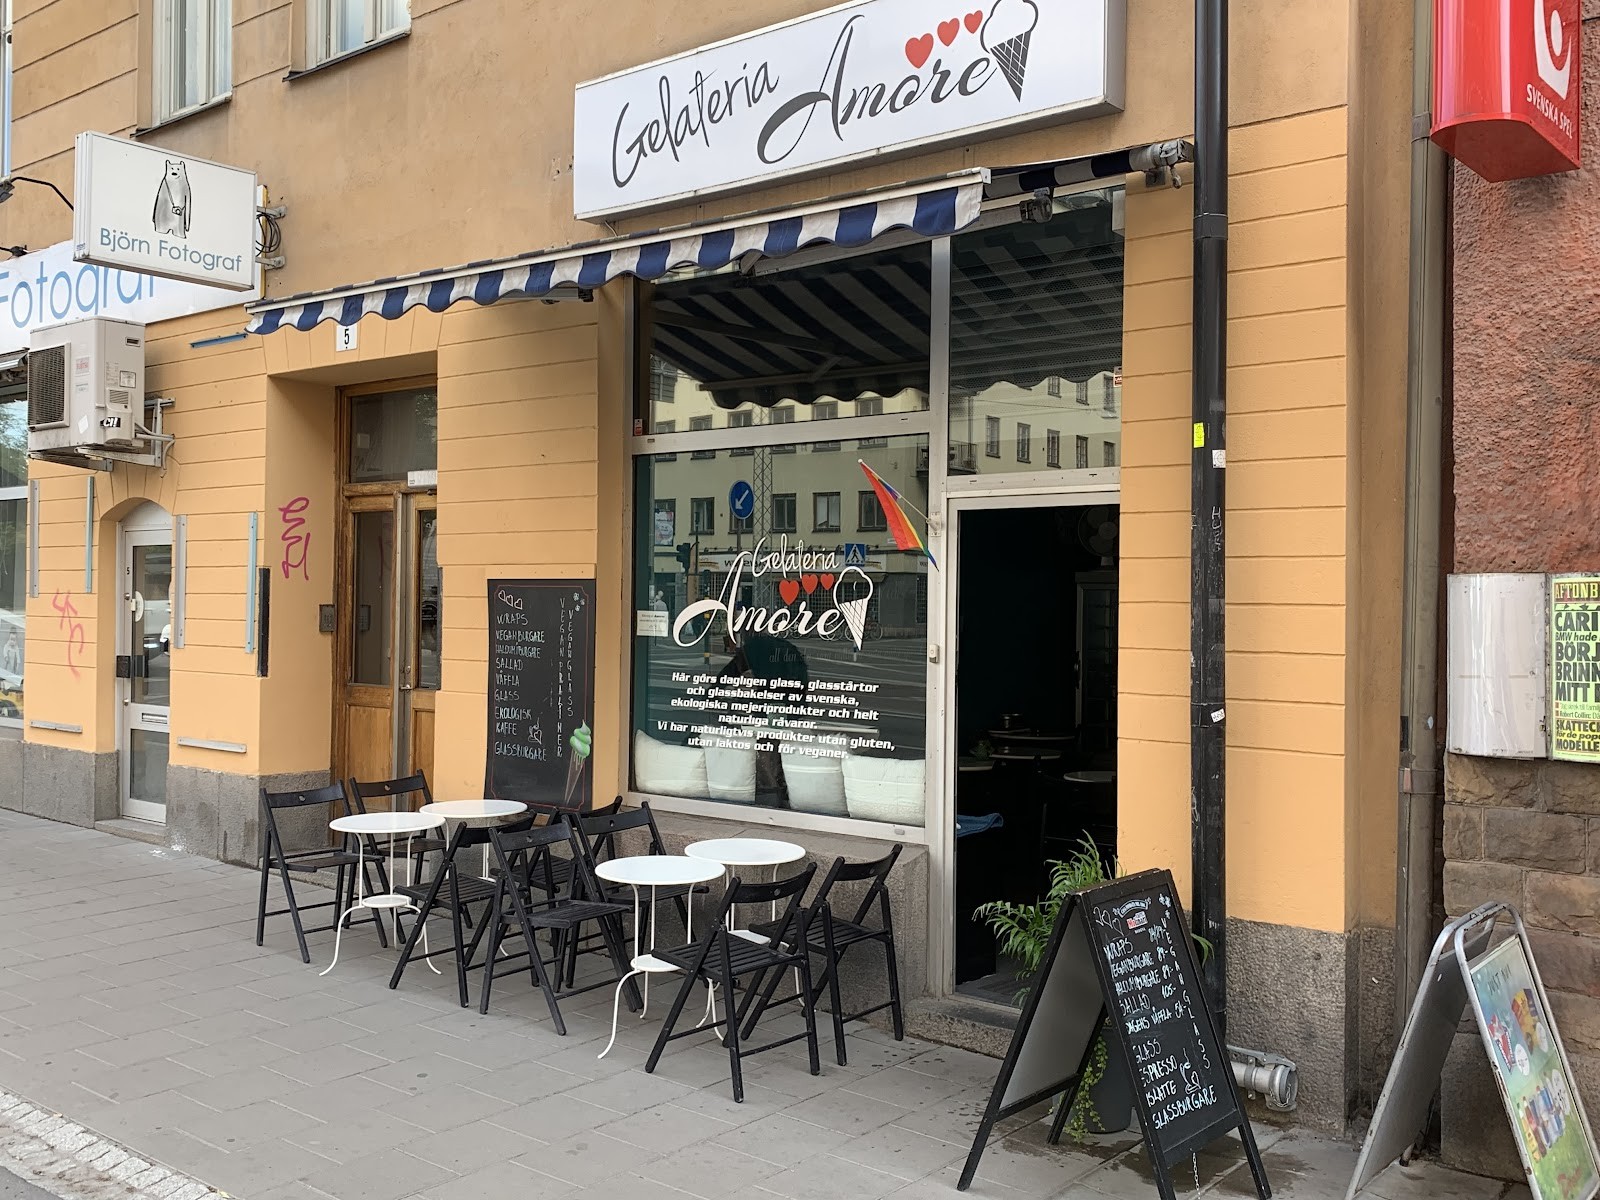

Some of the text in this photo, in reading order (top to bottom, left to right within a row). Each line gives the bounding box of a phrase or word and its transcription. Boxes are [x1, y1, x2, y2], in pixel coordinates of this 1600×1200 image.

[613, 14, 997, 188] Gelateria Amore
[1526, 83, 1573, 139] SVENSKA SPEL
[100, 227, 242, 272] Björn Fotograf
[344, 327, 350, 345] 5
[752, 533, 839, 579] Gelateria
[673, 551, 846, 647] Amore
[496, 612, 529, 626] WRAPS
[1555, 632, 1598, 641] BMW hade
[495, 657, 524, 671] SALLAD
[672, 672, 880, 693] Här görs dagligen glass, glasstårtor
[1556, 682, 1591, 702] MITT
[495, 688, 520, 702] GLASS
[686, 686, 860, 707] och glassbakelser av svenska,
[495, 706, 532, 721] EKOLOGISK
[670, 697, 880, 721] ekologiska mejeriprodukter och helt
[496, 721, 518, 736] KAFFE
[718, 714, 818, 729] naturliga råvaror.
[657, 720, 896, 752] Vi har naturligtvis produkter utan gluten,
[1557, 730, 1566, 738] för
[1566, 731, 1578, 739] de
[687, 737, 850, 760] utan laktos och för veganer.
[1103, 937, 1134, 960] WRAPS
[1119, 993, 1151, 1016] SALLAD
[1145, 1080, 1177, 1107] ISLATTE
[1152, 1084, 1217, 1130] GLASSBURGARE
